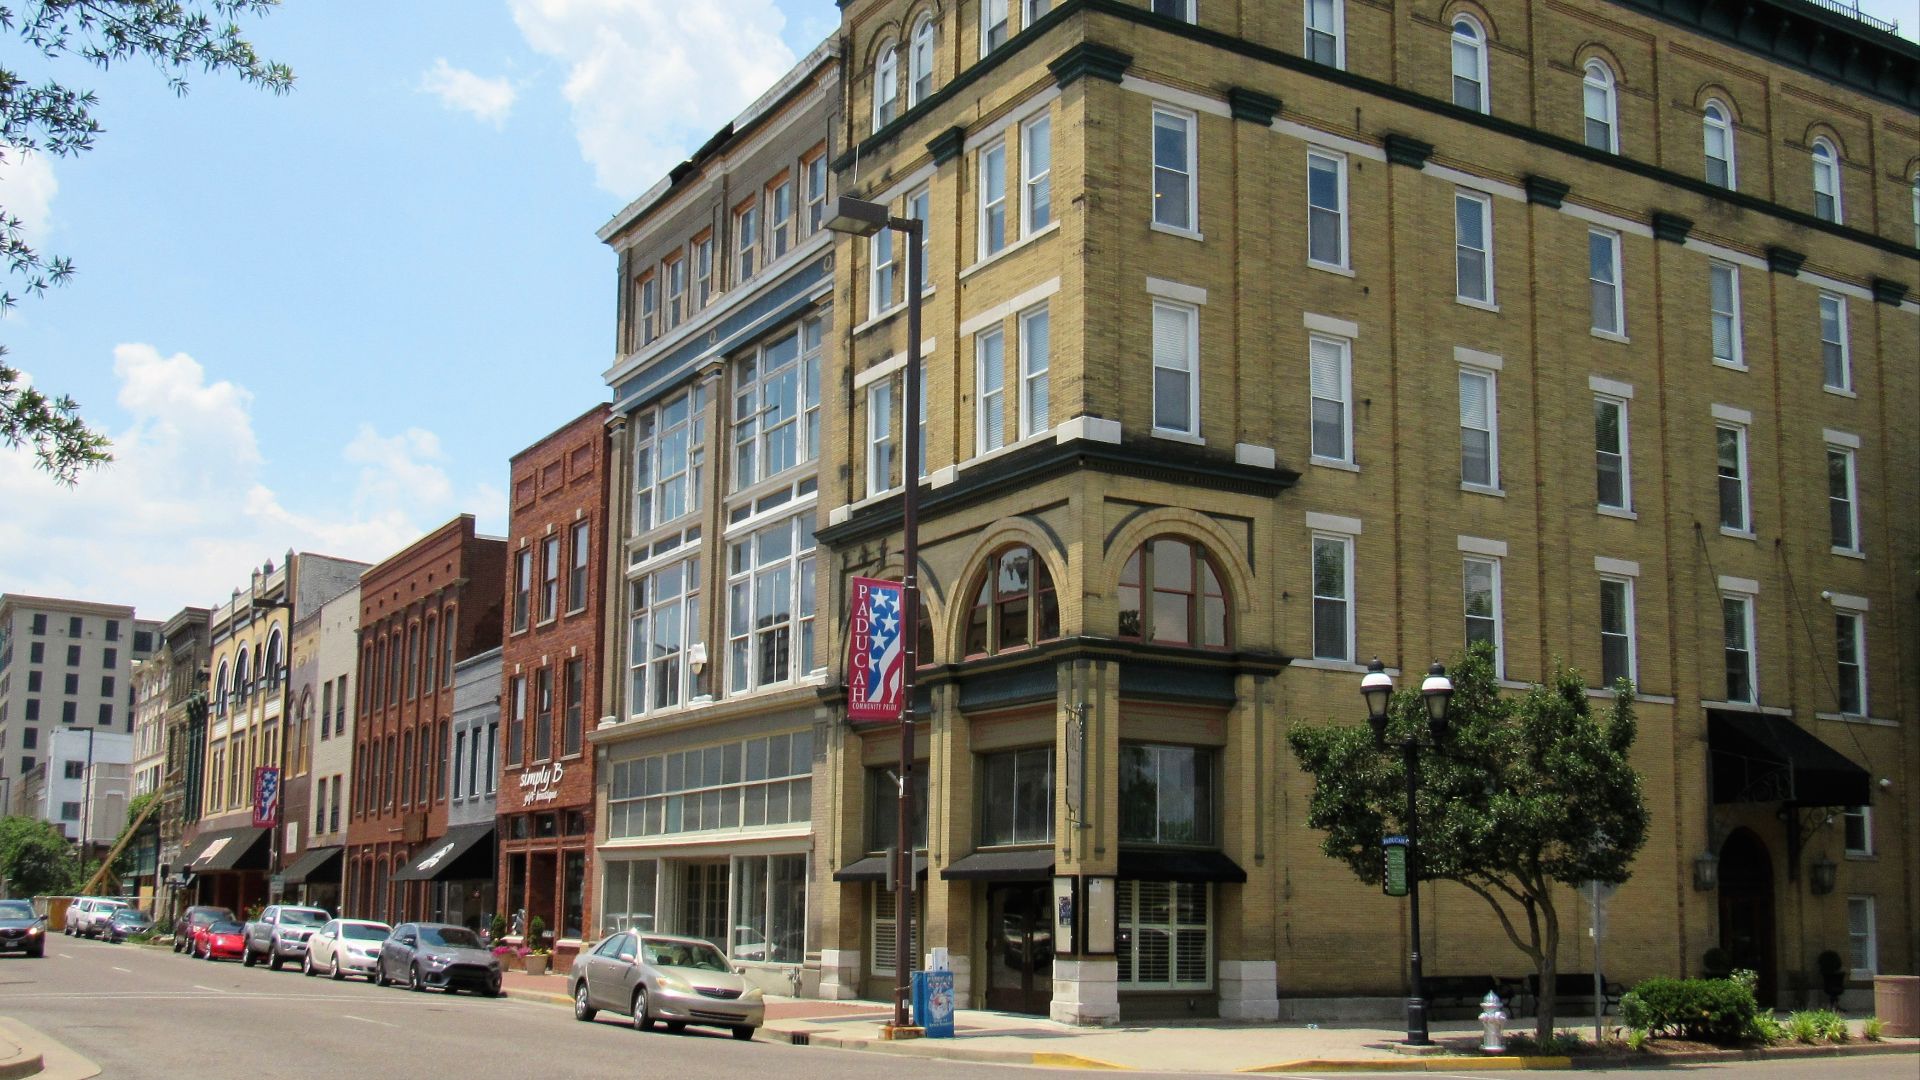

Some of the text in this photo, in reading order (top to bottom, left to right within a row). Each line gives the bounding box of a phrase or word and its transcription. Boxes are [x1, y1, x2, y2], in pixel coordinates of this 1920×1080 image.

[853, 584, 869, 702] PADUCAH
[852, 702, 881, 710] COMMUNITY
[520, 762, 563, 792] simply B
